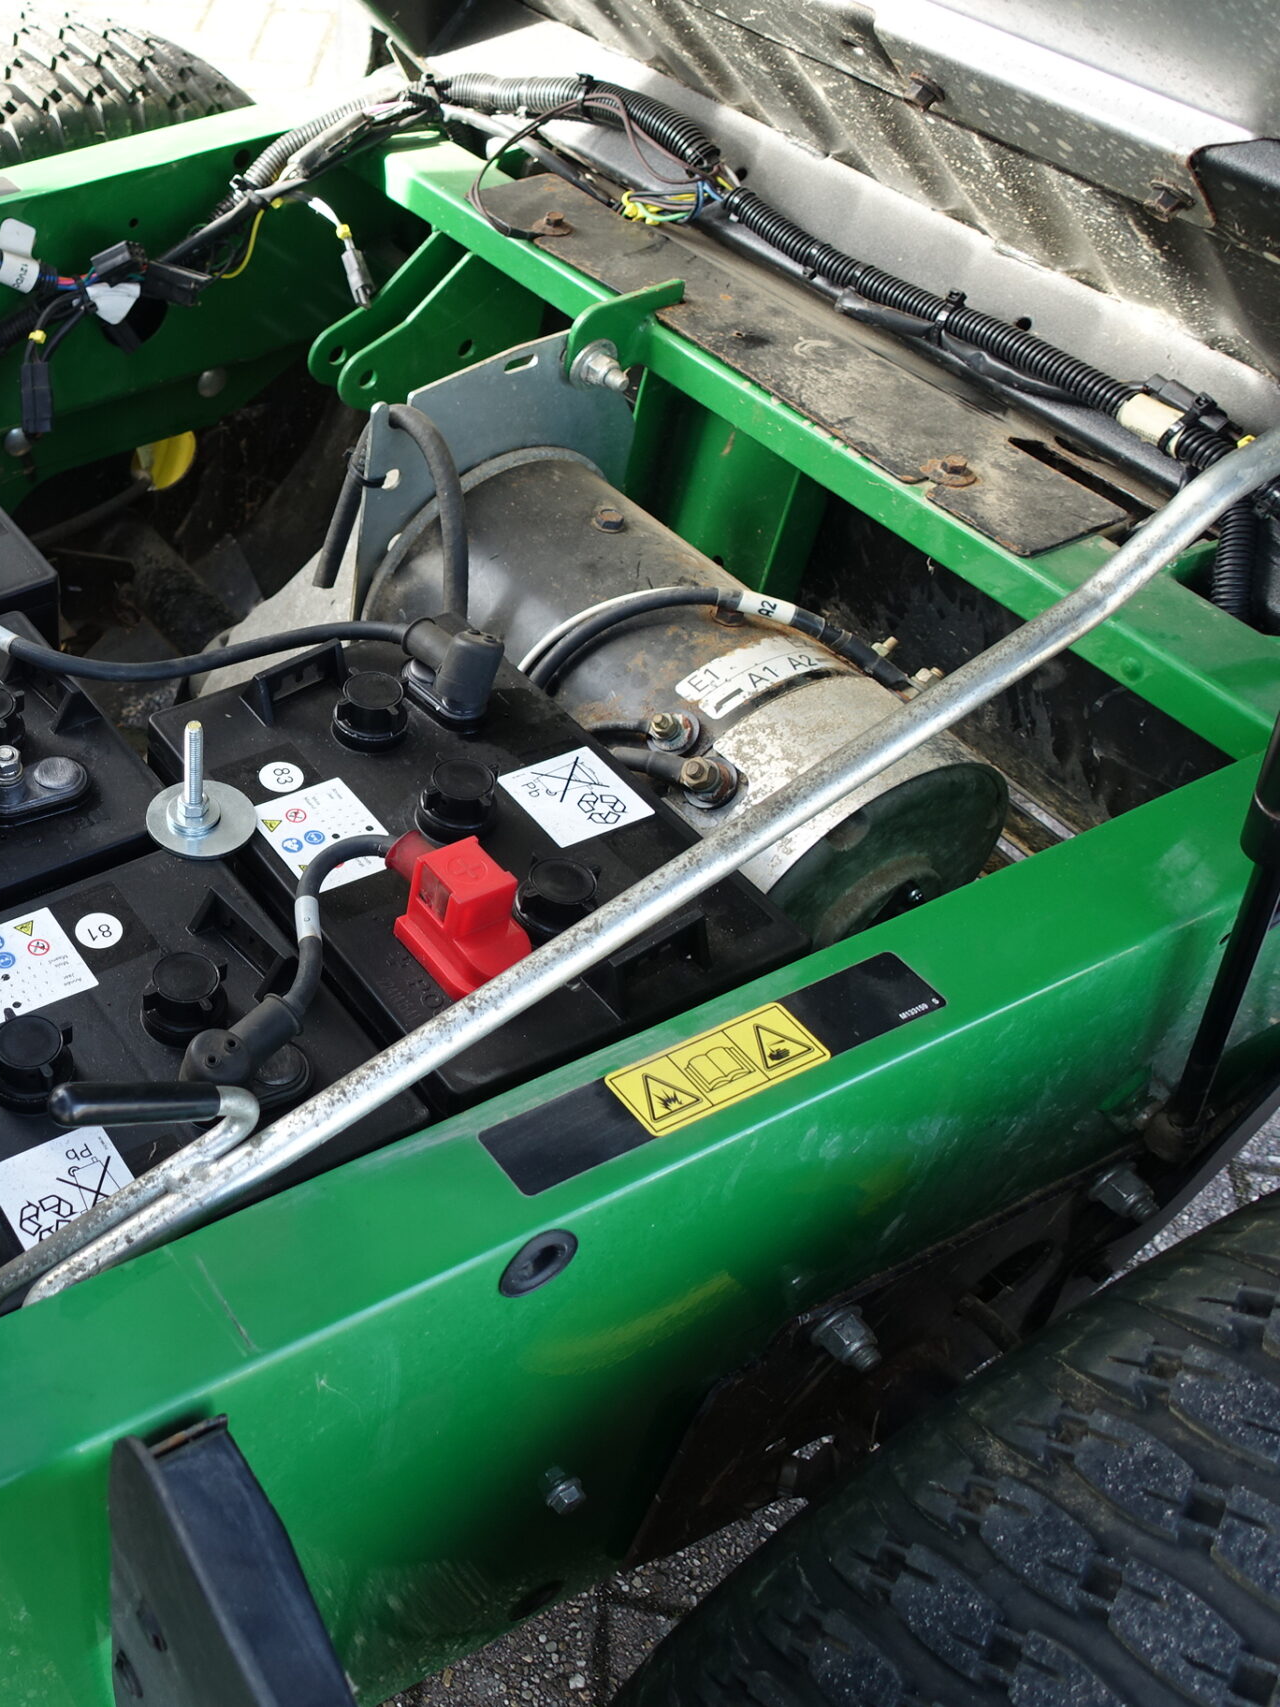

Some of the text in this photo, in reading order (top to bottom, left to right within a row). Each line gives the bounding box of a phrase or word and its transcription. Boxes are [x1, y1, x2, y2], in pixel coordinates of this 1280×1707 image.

[757, 600, 777, 618] A2
[786, 654, 818, 671] A2
[687, 668, 720, 693] E1
[747, 665, 780, 689] A1
[272, 767, 294, 785] 83
[521, 781, 541, 798] Pb
[87, 923, 112, 941] 81
[66, 1143, 93, 1162] Pb
